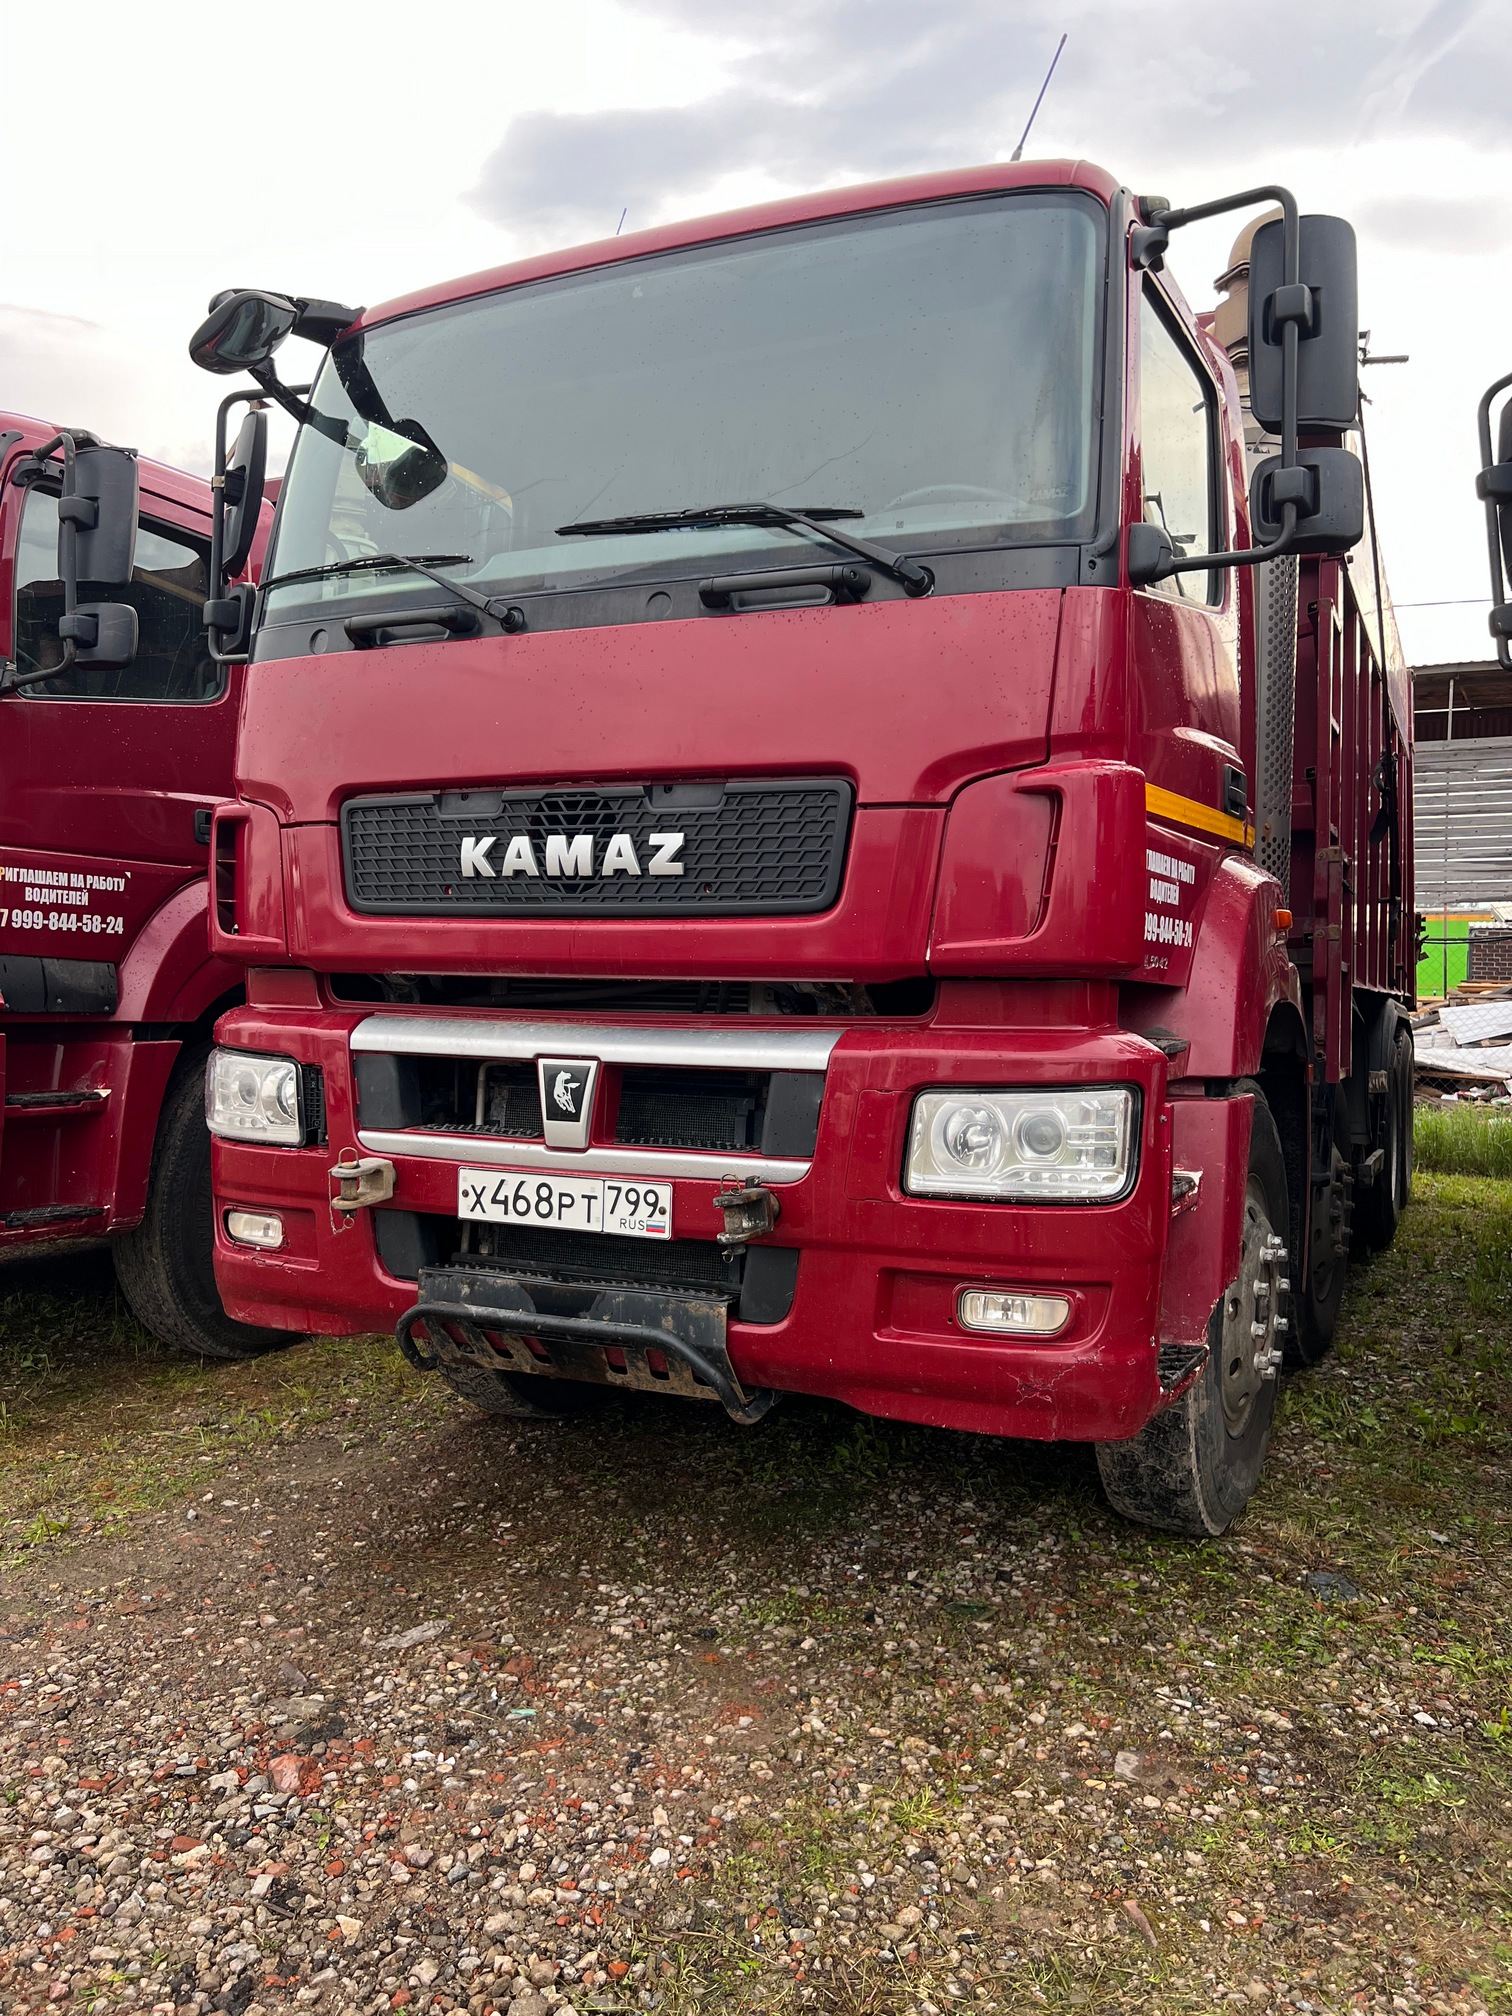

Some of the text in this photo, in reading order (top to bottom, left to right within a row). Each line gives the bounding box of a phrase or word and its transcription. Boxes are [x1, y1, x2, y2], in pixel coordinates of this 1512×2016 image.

[460, 832, 685, 877] KAMAZ
[70, 873, 85, 888] НА
[86, 874, 126, 892] РАБОТУ
[24, 886, 89, 906] ВОДИТЕЛЕЙ
[11, 908, 124, 935] 999-844-58-24
[607, 1185, 660, 1218] 799
[619, 1218, 645, 1231] RUS
